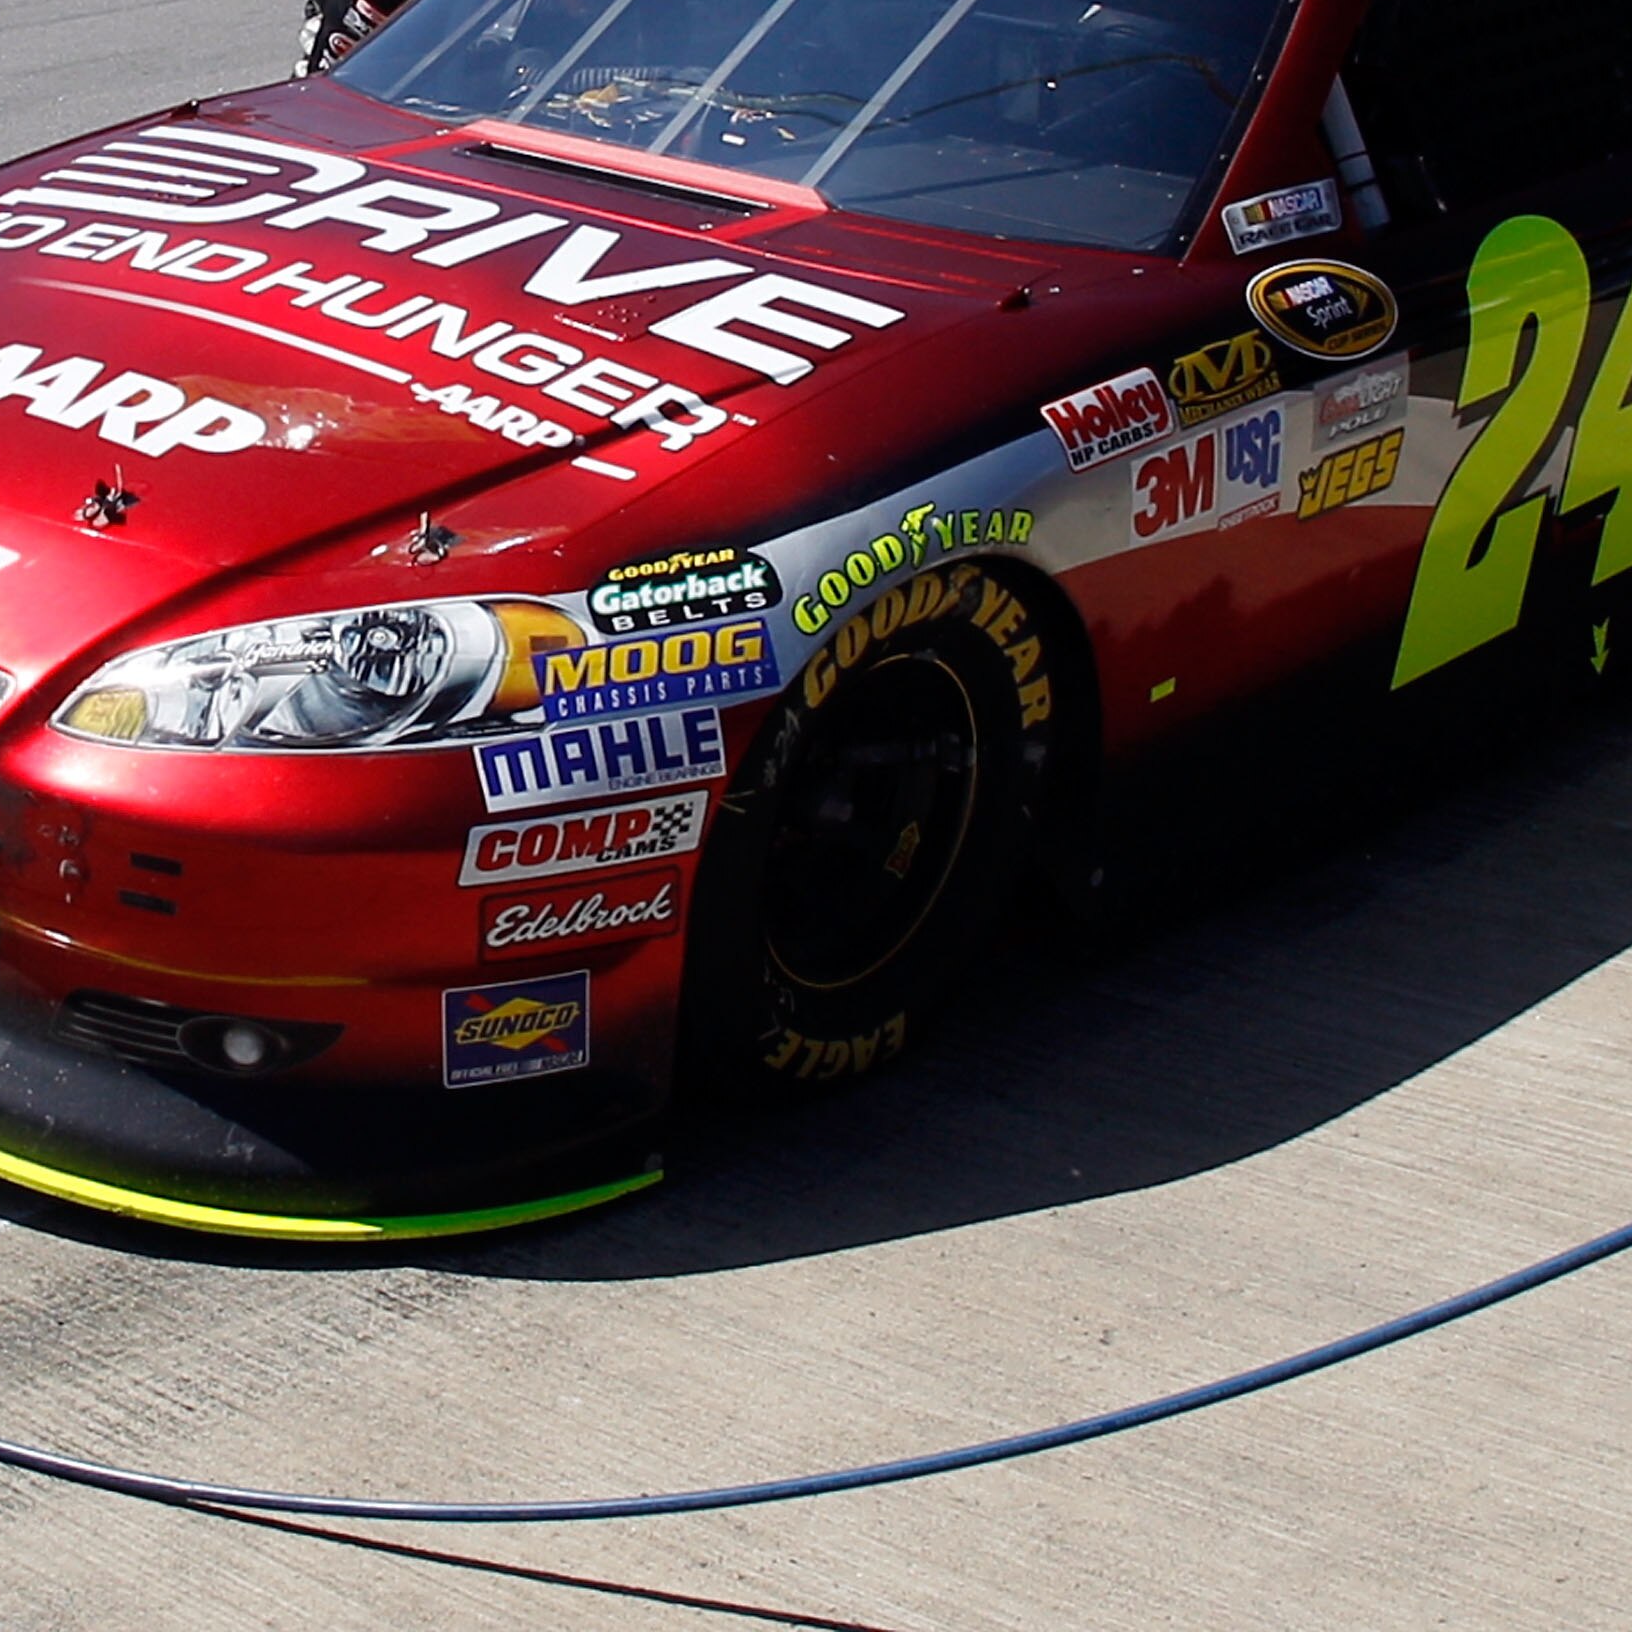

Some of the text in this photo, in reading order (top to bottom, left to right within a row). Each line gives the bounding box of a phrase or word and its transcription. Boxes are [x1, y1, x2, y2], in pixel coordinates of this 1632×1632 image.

[1239, 213, 1332, 245] RACE CAR
[1269, 187, 1322, 219] NASCAR
[1285, 275, 1335, 307] NASCAR
[1305, 297, 1354, 330] Sprint
[43, 226, 261, 284] END
[241, 260, 728, 453] HUNGER
[410, 379, 574, 451] AARP
[1048, 376, 1167, 452] Holley
[1179, 371, 1282, 427] MECHANIX WEAR
[1070, 422, 1154, 467] HP CARBS
[1224, 409, 1281, 489] USG
[1298, 427, 1405, 520] JEGS
[1133, 433, 1217, 538] 3M
[592, 563, 768, 618] Gatorback
[607, 547, 736, 582] GOODYEAR
[791, 503, 1035, 635] GOODYEAR
[611, 590, 768, 633] BELTS
[542, 619, 765, 697] MOOG
[804, 565, 1053, 728] GOODYEAR
[556, 666, 765, 720] CHASSIS PARTS
[478, 708, 722, 798] MAHLE
[474, 808, 652, 872] COMP
[596, 834, 678, 865] CAMS
[486, 882, 673, 950] Edelbrock
[460, 1004, 575, 1042] SUNOCO
[763, 1009, 907, 1079] EAGLE
